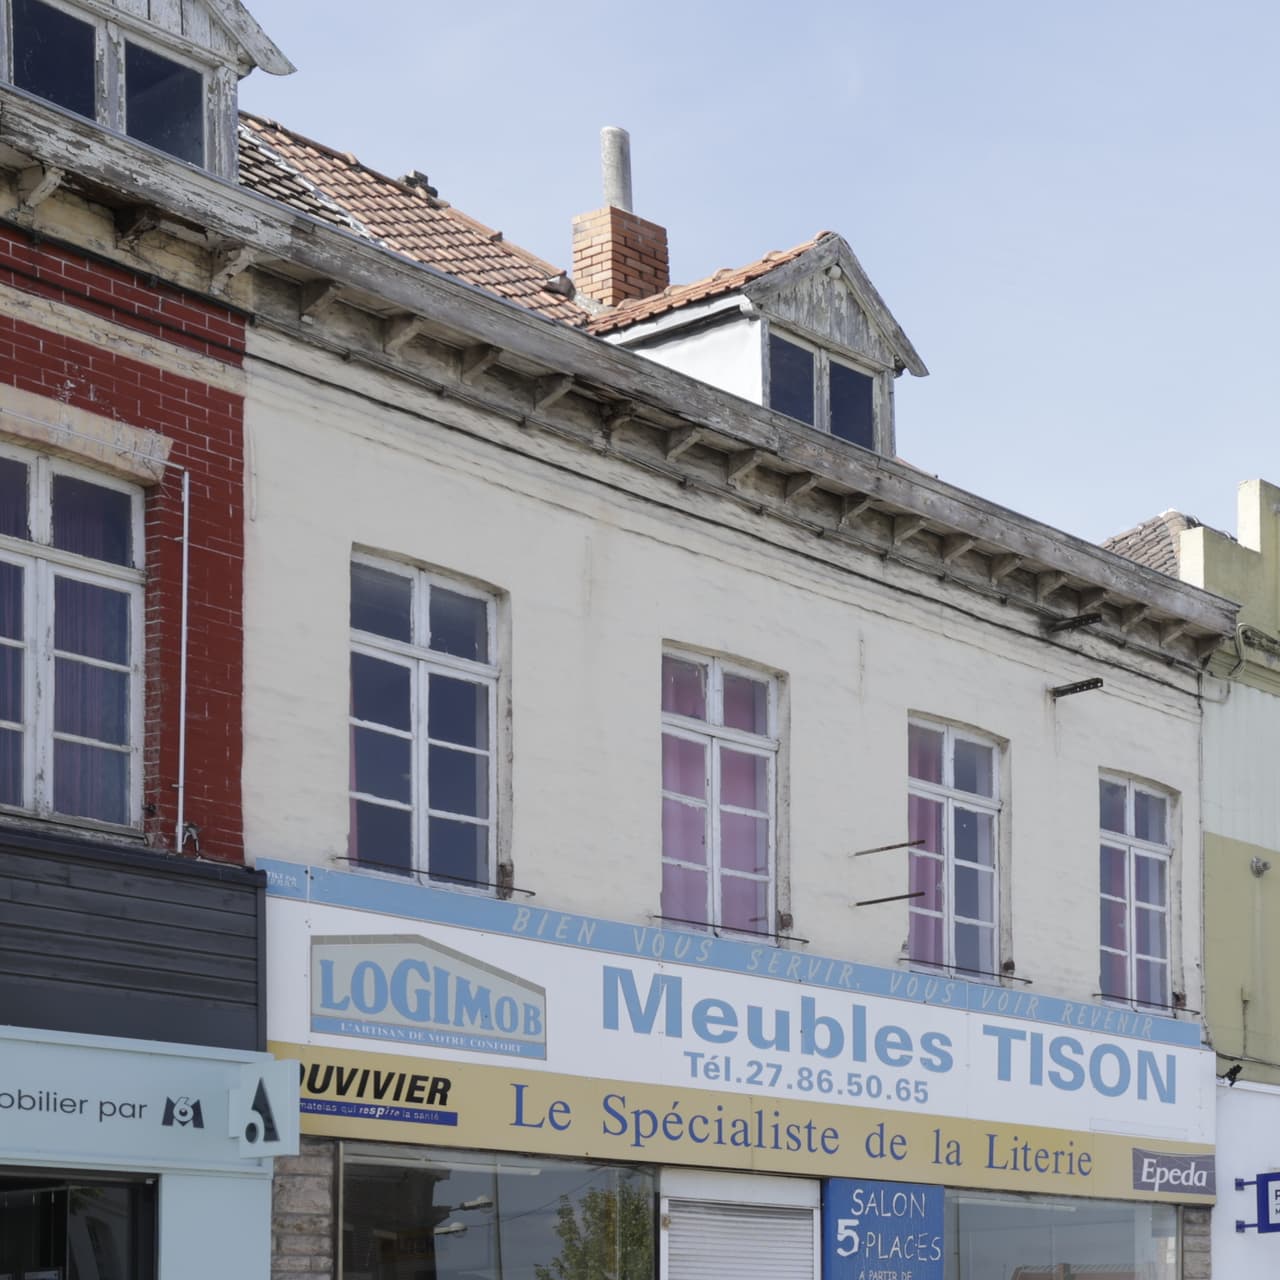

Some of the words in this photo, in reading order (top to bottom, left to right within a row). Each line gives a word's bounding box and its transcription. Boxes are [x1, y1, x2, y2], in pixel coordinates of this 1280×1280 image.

[511, 906, 598, 945] BIEN
[632, 926, 714, 963] VOUS
[888, 971, 957, 1004] VOUS
[980, 987, 1042, 1020] VOIR
[1061, 1001, 1154, 1039] REVENIR
[319, 957, 543, 1036] LOGIMOB
[340, 1021, 406, 1040] L'ARTISAN
[409, 1031, 424, 1041] DE
[429, 1033, 466, 1047] VOTRE
[469, 1038, 522, 1054] CONFORT
[602, 966, 954, 1075] Meubles
[982, 1024, 1178, 1105] TISON
[300, 1063, 452, 1106] UVIVIER
[99, 1099, 148, 1123] par
[508, 1082, 572, 1133] Le
[601, 1093, 841, 1156] Spécialiste
[864, 1123, 909, 1162] de
[932, 1127, 964, 1167] la
[984, 1133, 1094, 1177] Literie
[1139, 1157, 1209, 1194] Epeda
[850, 1188, 926, 1218] SALON
[836, 1218, 860, 1257] 5
[864, 1231, 942, 1262] PLACES
